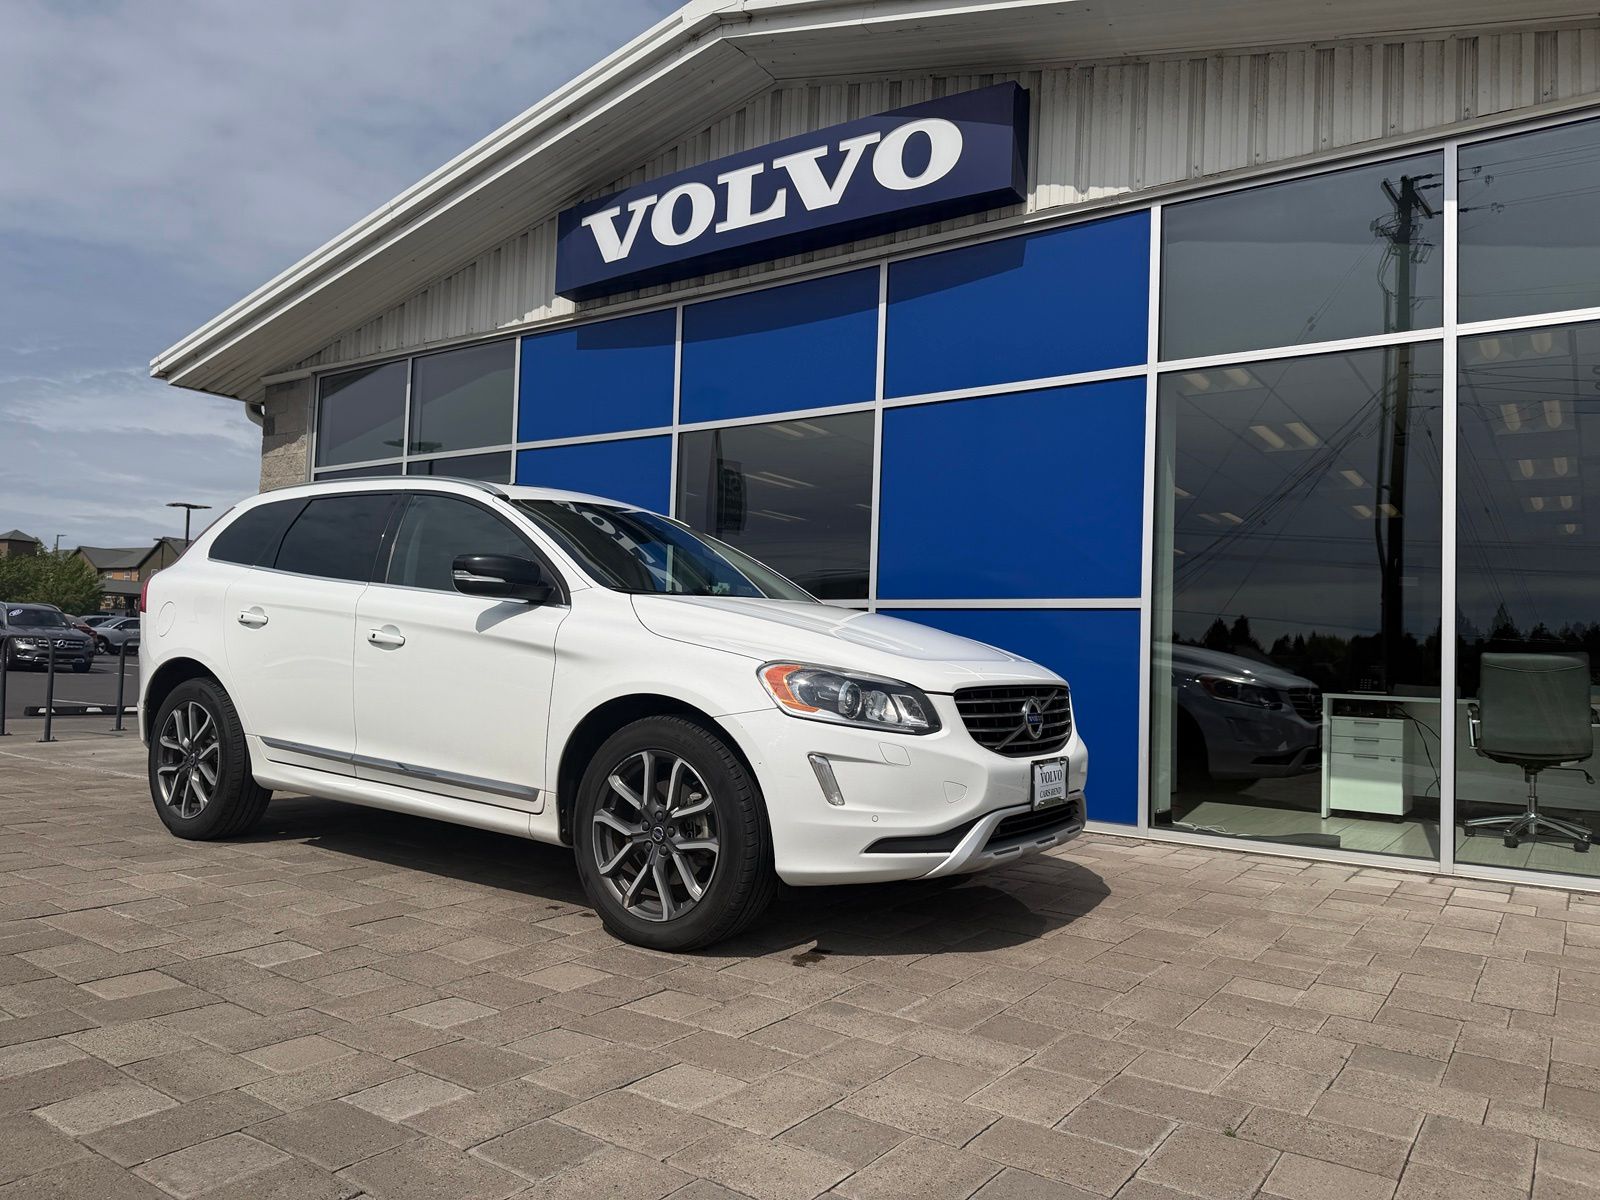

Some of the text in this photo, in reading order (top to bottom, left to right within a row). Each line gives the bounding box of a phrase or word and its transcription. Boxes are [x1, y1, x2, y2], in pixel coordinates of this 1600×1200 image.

[581, 118, 963, 263] VOLVO
[1040, 769, 1063, 783] VOLVO
[1040, 788, 1050, 798] CARS
